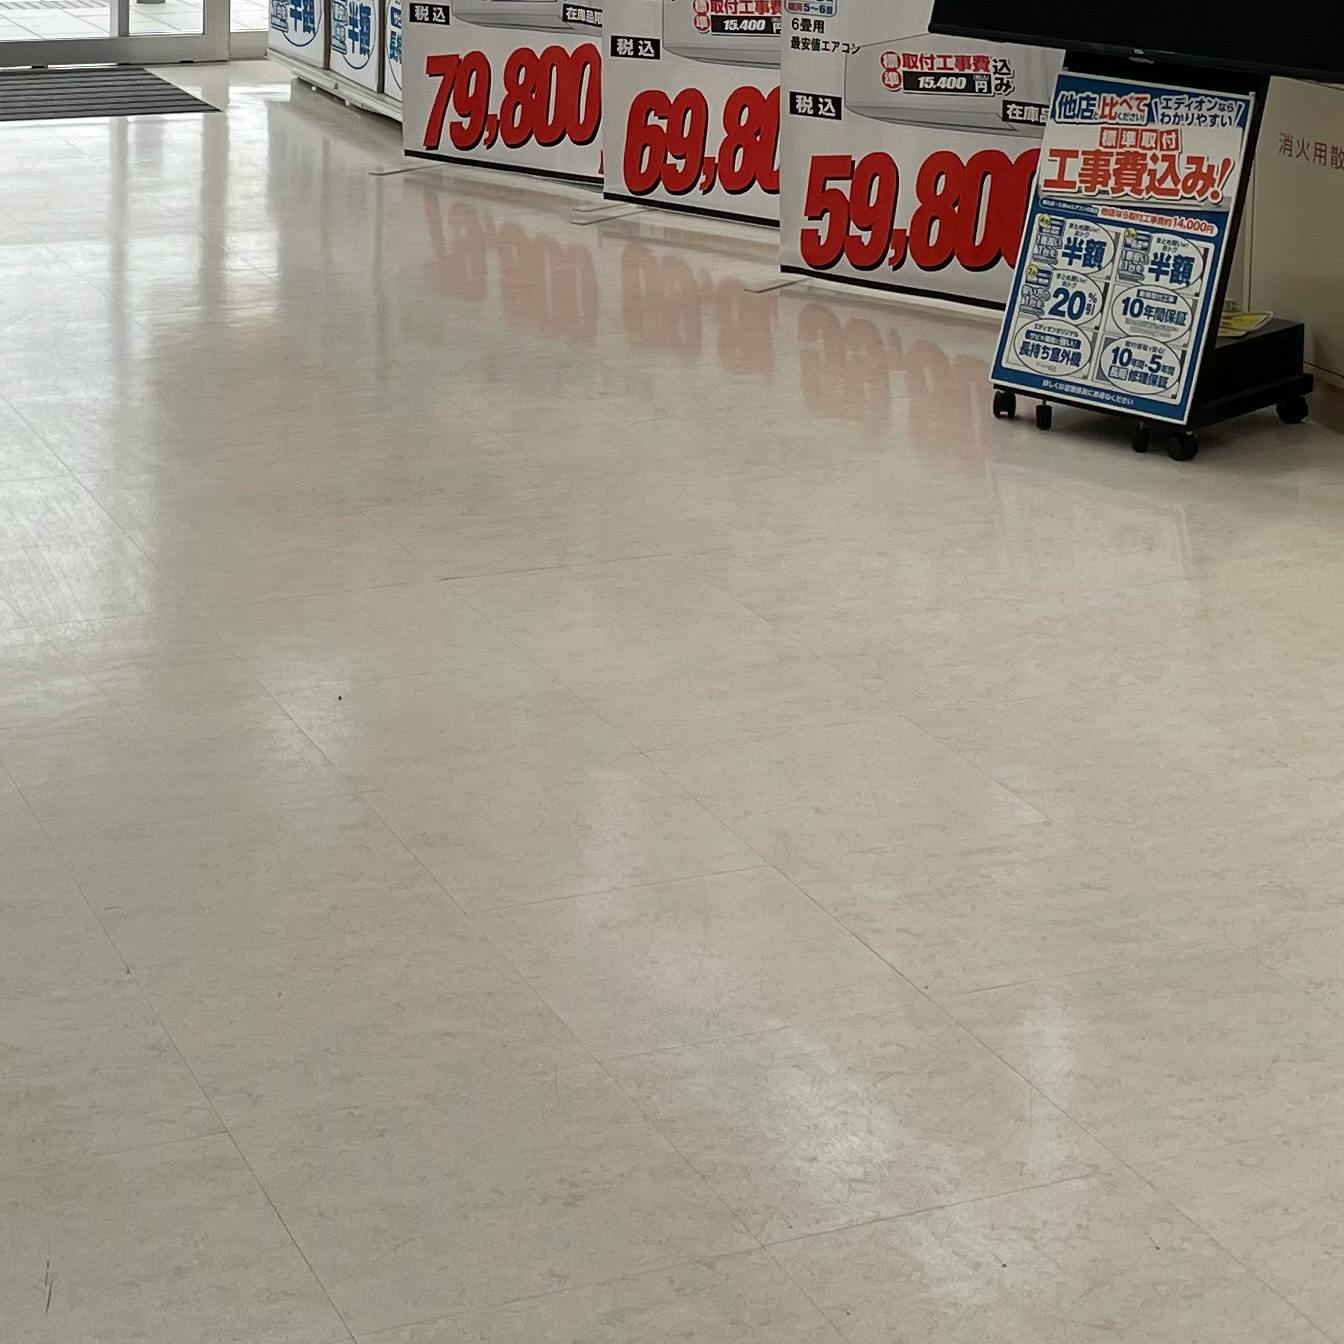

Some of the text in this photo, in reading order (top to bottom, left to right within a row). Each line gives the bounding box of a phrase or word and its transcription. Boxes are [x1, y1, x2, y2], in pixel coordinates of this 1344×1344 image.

[414, 6, 447, 24] 税込
[791, 17, 825, 34] 6畳用
[616, 37, 656, 58] 税込
[790, 36, 861, 56] 最安値エアコン
[901, 53, 991, 74] 取付工事費
[422, 43, 603, 151] 79,800
[795, 94, 837, 118] 税込
[1159, 94, 1236, 114] エディオンなら
[1159, 111, 1235, 128] わかりやすい
[1100, 127, 1181, 151] 標準取付
[1042, 147, 1235, 201] 工事費込み!
[1061, 236, 1108, 271] 半額
[1148, 252, 1196, 287] 半額
[1047, 287, 1087, 322] 20
[1121, 296, 1187, 328] 10年間保証
